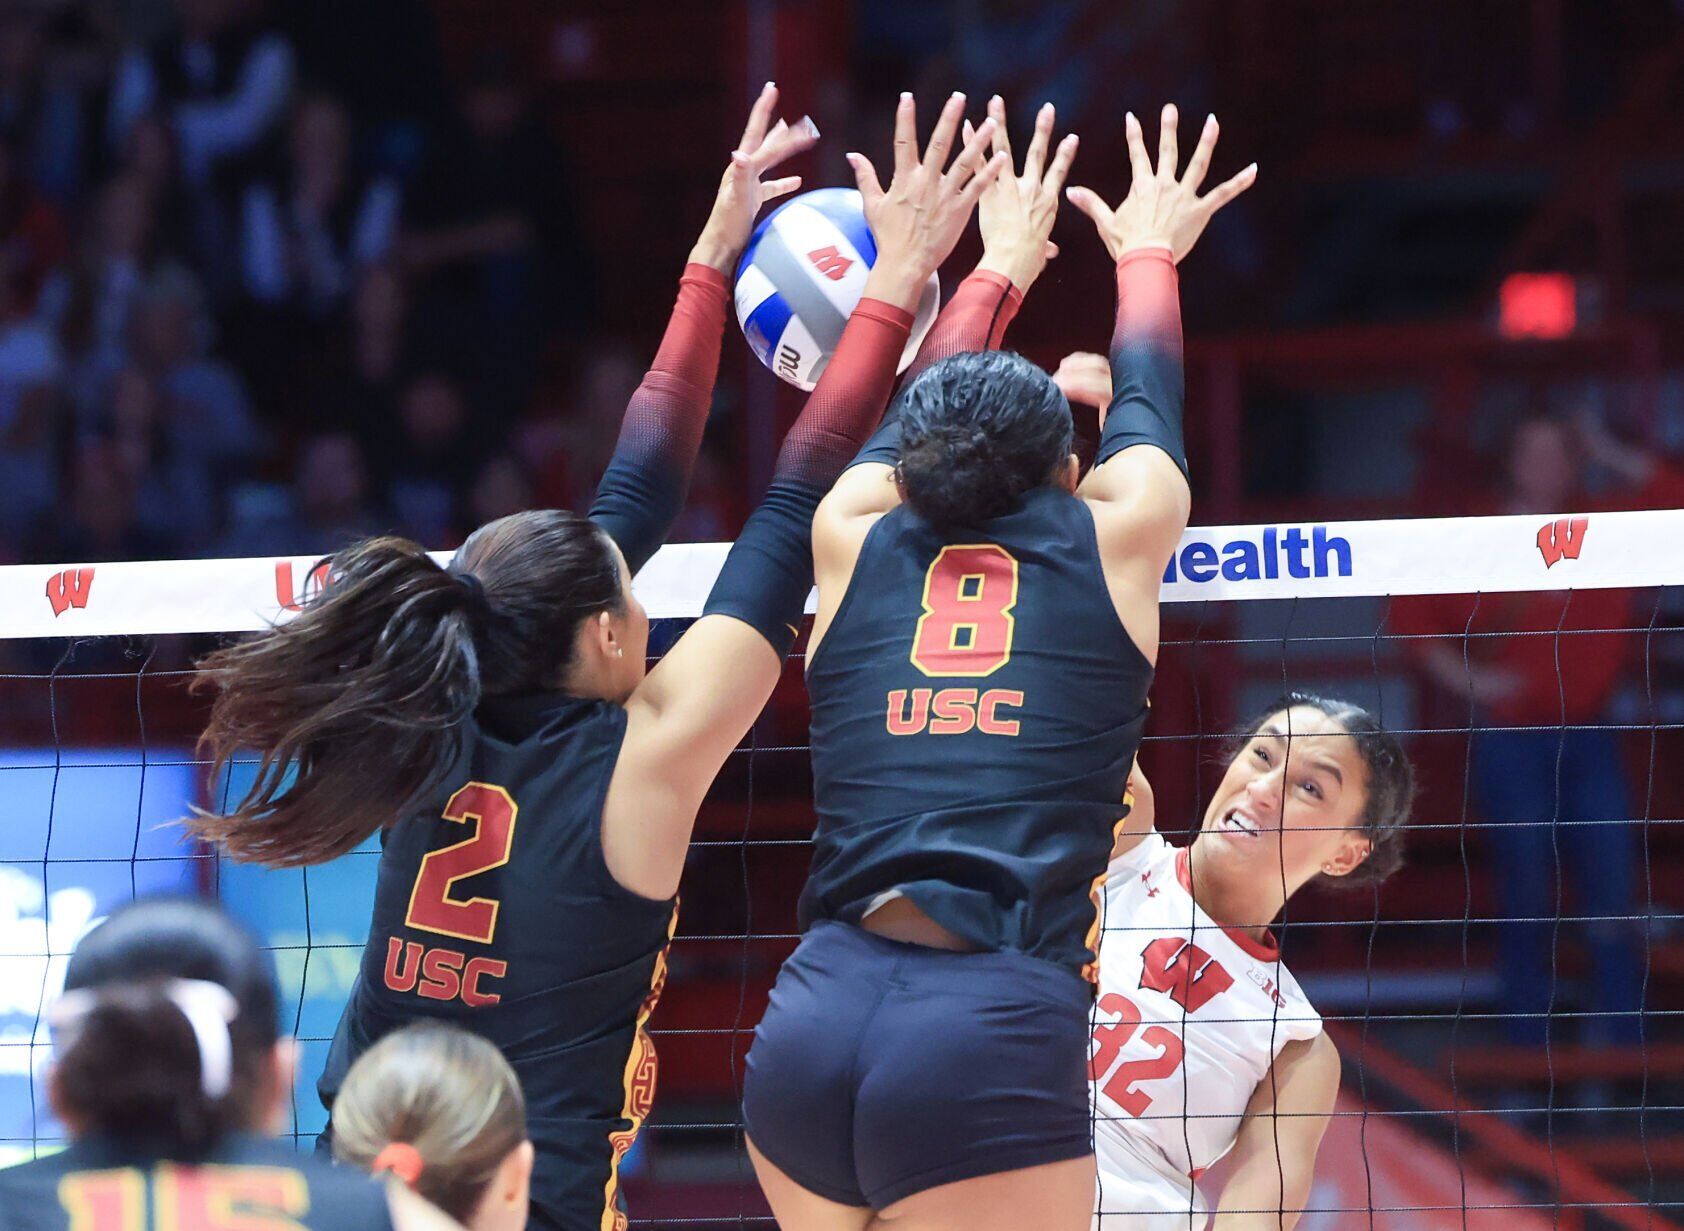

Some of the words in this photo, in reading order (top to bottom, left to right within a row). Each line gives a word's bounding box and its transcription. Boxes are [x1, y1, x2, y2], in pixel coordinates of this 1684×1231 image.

[1536, 516, 1589, 570] W
[46, 567, 96, 618] W
[910, 544, 1019, 677] 8
[887, 688, 1025, 736] USC
[404, 780, 519, 945] 2
[384, 936, 507, 1007] USC
[1087, 993, 1186, 1118] 32
